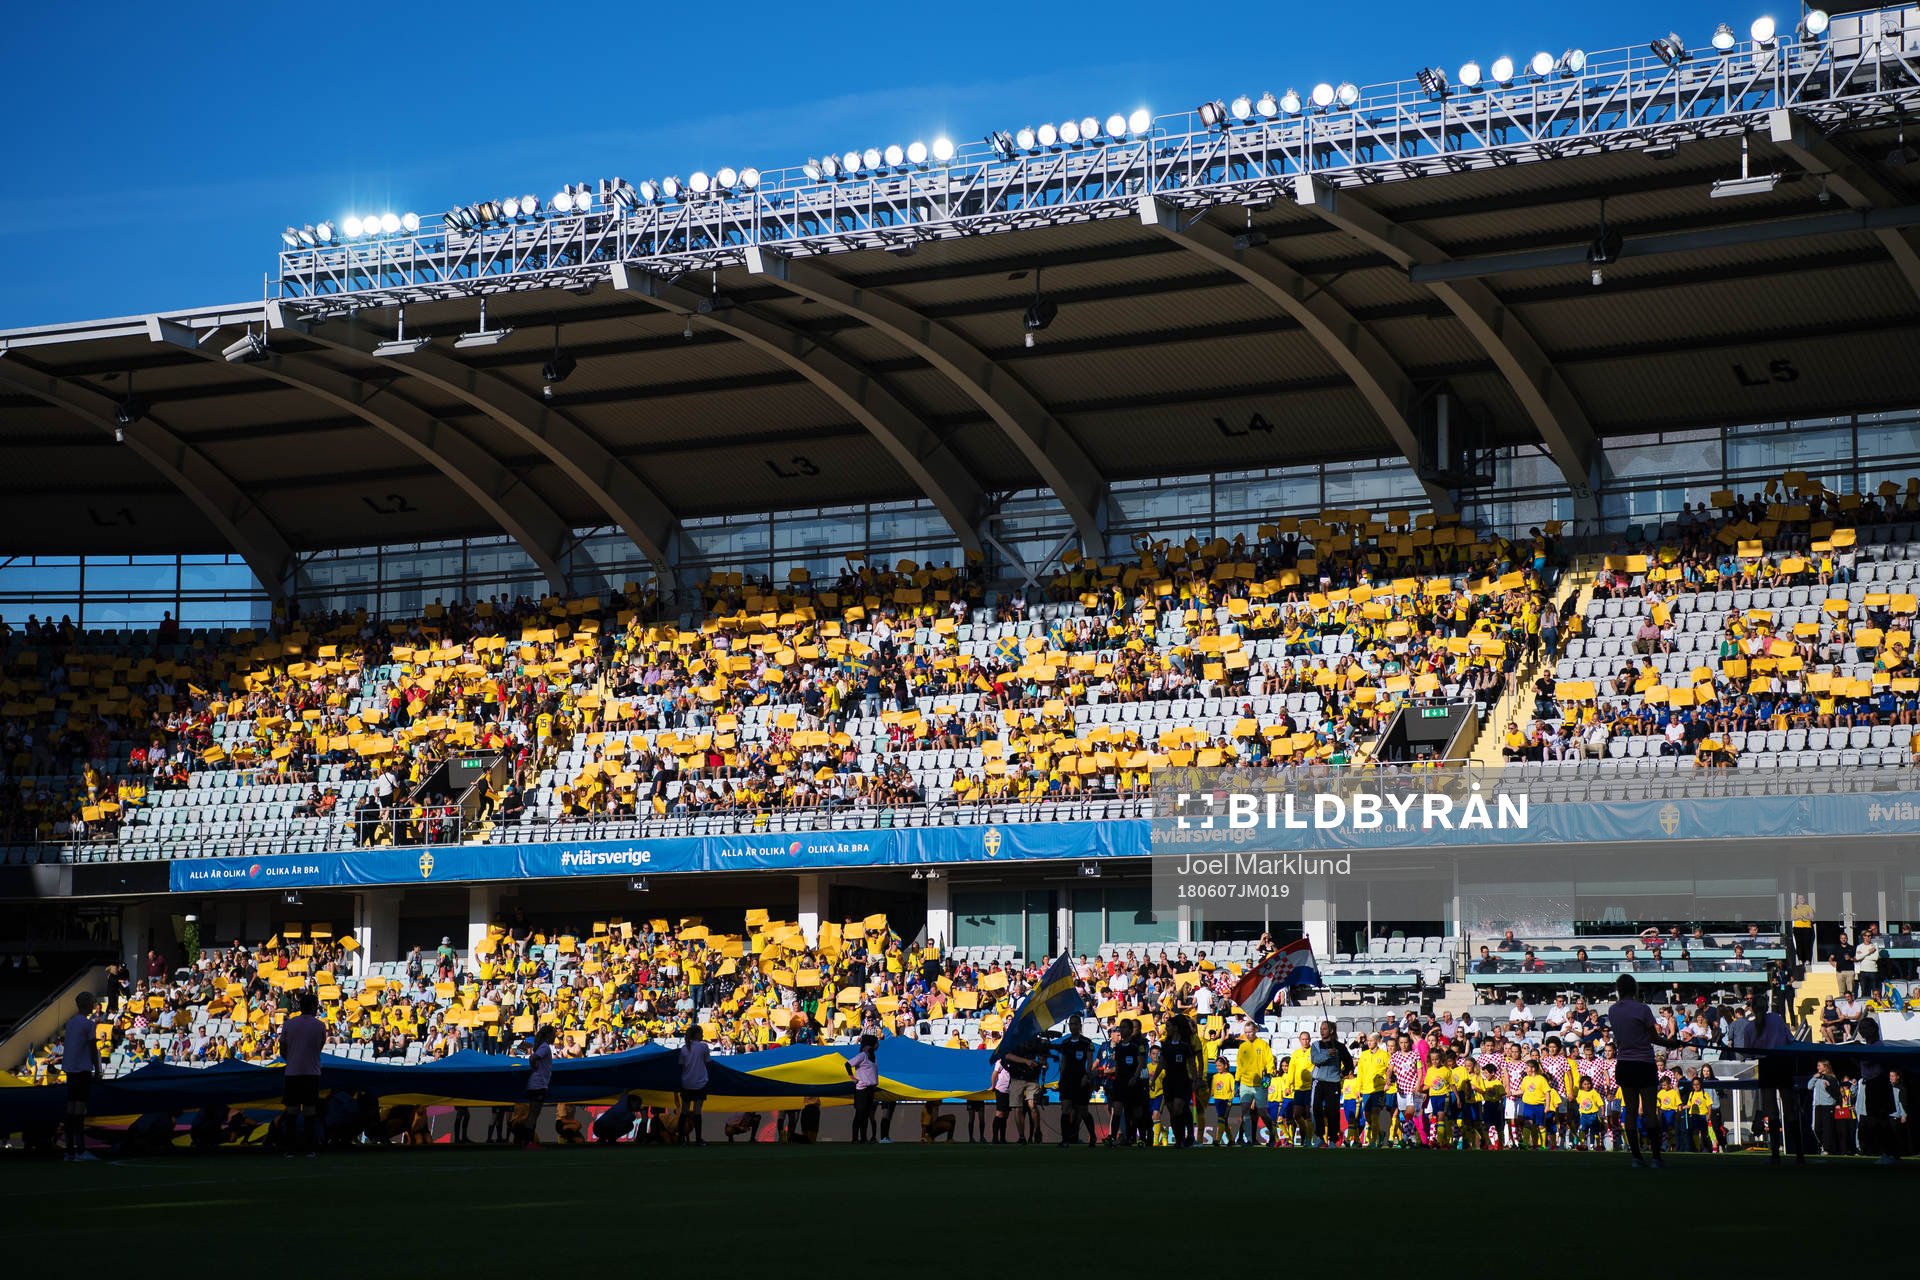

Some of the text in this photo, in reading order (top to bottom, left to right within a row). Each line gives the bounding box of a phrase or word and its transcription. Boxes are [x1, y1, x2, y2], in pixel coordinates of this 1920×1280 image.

[1733, 359, 1798, 386] L5
[1213, 412, 1274, 437] L4
[765, 456, 820, 478] L3
[361, 494, 417, 514] L2
[89, 508, 137, 527] L1
[561, 847, 651, 866] #viärsverige
[721, 847, 785, 857] ALLA ÄR OLIKA
[808, 843, 869, 854] OLIKA ÄR BRA
[190, 869, 246, 879] ALLA ÄR OLIKA
[266, 866, 319, 876] OLIKA ÄR BRA
